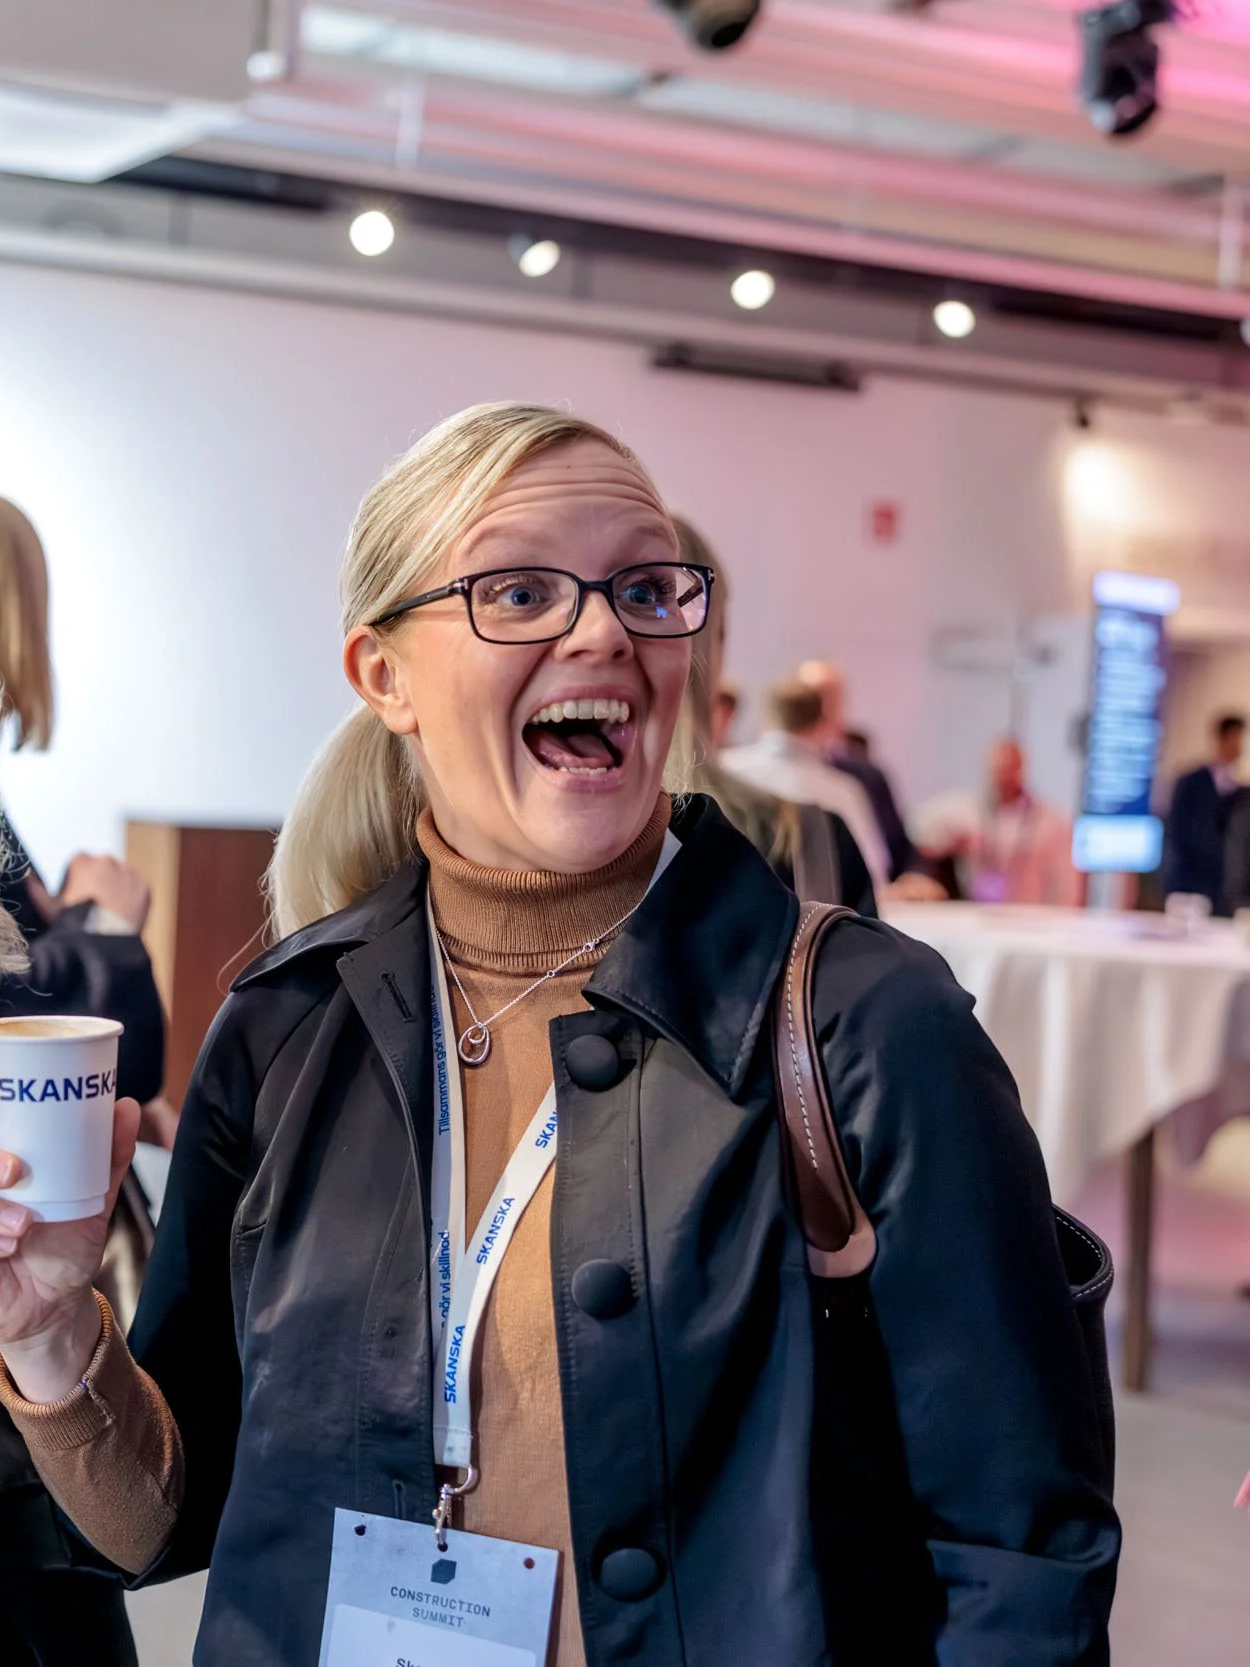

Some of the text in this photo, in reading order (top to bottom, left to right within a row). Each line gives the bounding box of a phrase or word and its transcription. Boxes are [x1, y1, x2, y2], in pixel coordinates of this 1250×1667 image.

[436, 1041, 447, 1061] gör
[436, 1061, 451, 1136] Tillsammans
[476, 1197, 516, 1265] SKANSKA
[439, 1282, 451, 1294] vi
[444, 1324, 466, 1404] SKANSKA
[390, 1586, 491, 1618] CONSTRUCTION
[412, 1607, 465, 1628] SUMMIT
